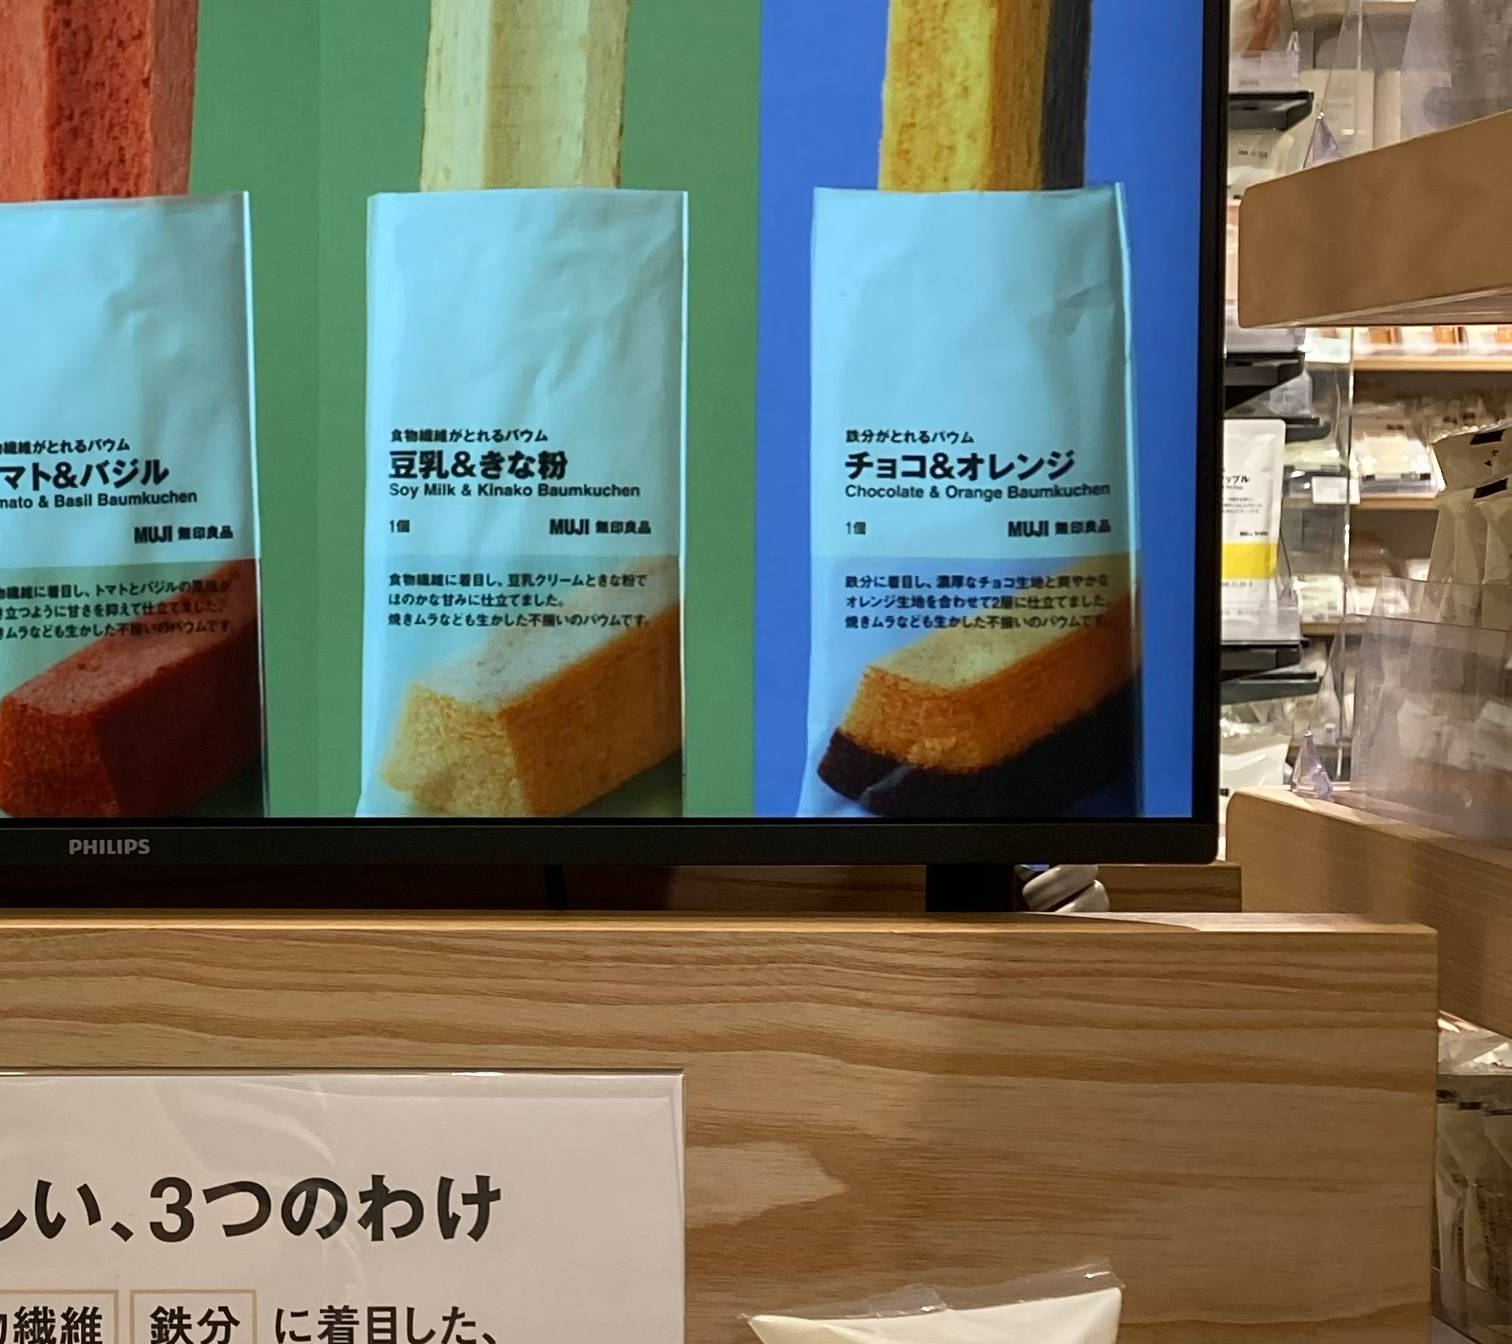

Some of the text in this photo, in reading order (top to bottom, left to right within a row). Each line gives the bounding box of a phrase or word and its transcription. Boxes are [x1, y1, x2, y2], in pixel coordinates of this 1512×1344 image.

[389, 450, 568, 480] 豆乳&きな粉
[845, 449, 1075, 481] チョコ&オレンジ
[38, 496, 49, 508] &
[54, 494, 92, 508] Basil
[98, 490, 197, 506] Baumkuchen
[389, 483, 640, 499] Soy Milk & Kinako Baumkuchen
[845, 483, 1110, 501] Chocolate & Orange Baumkuchen
[134, 525, 233, 544] MUJI 無印良品
[390, 519, 410, 533] 1個
[549, 519, 651, 535] MUJI 無印良品
[846, 521, 866, 535] 1個
[1008, 519, 1111, 538] MUJI 無印良品
[69, 839, 150, 855] PHILIPS
